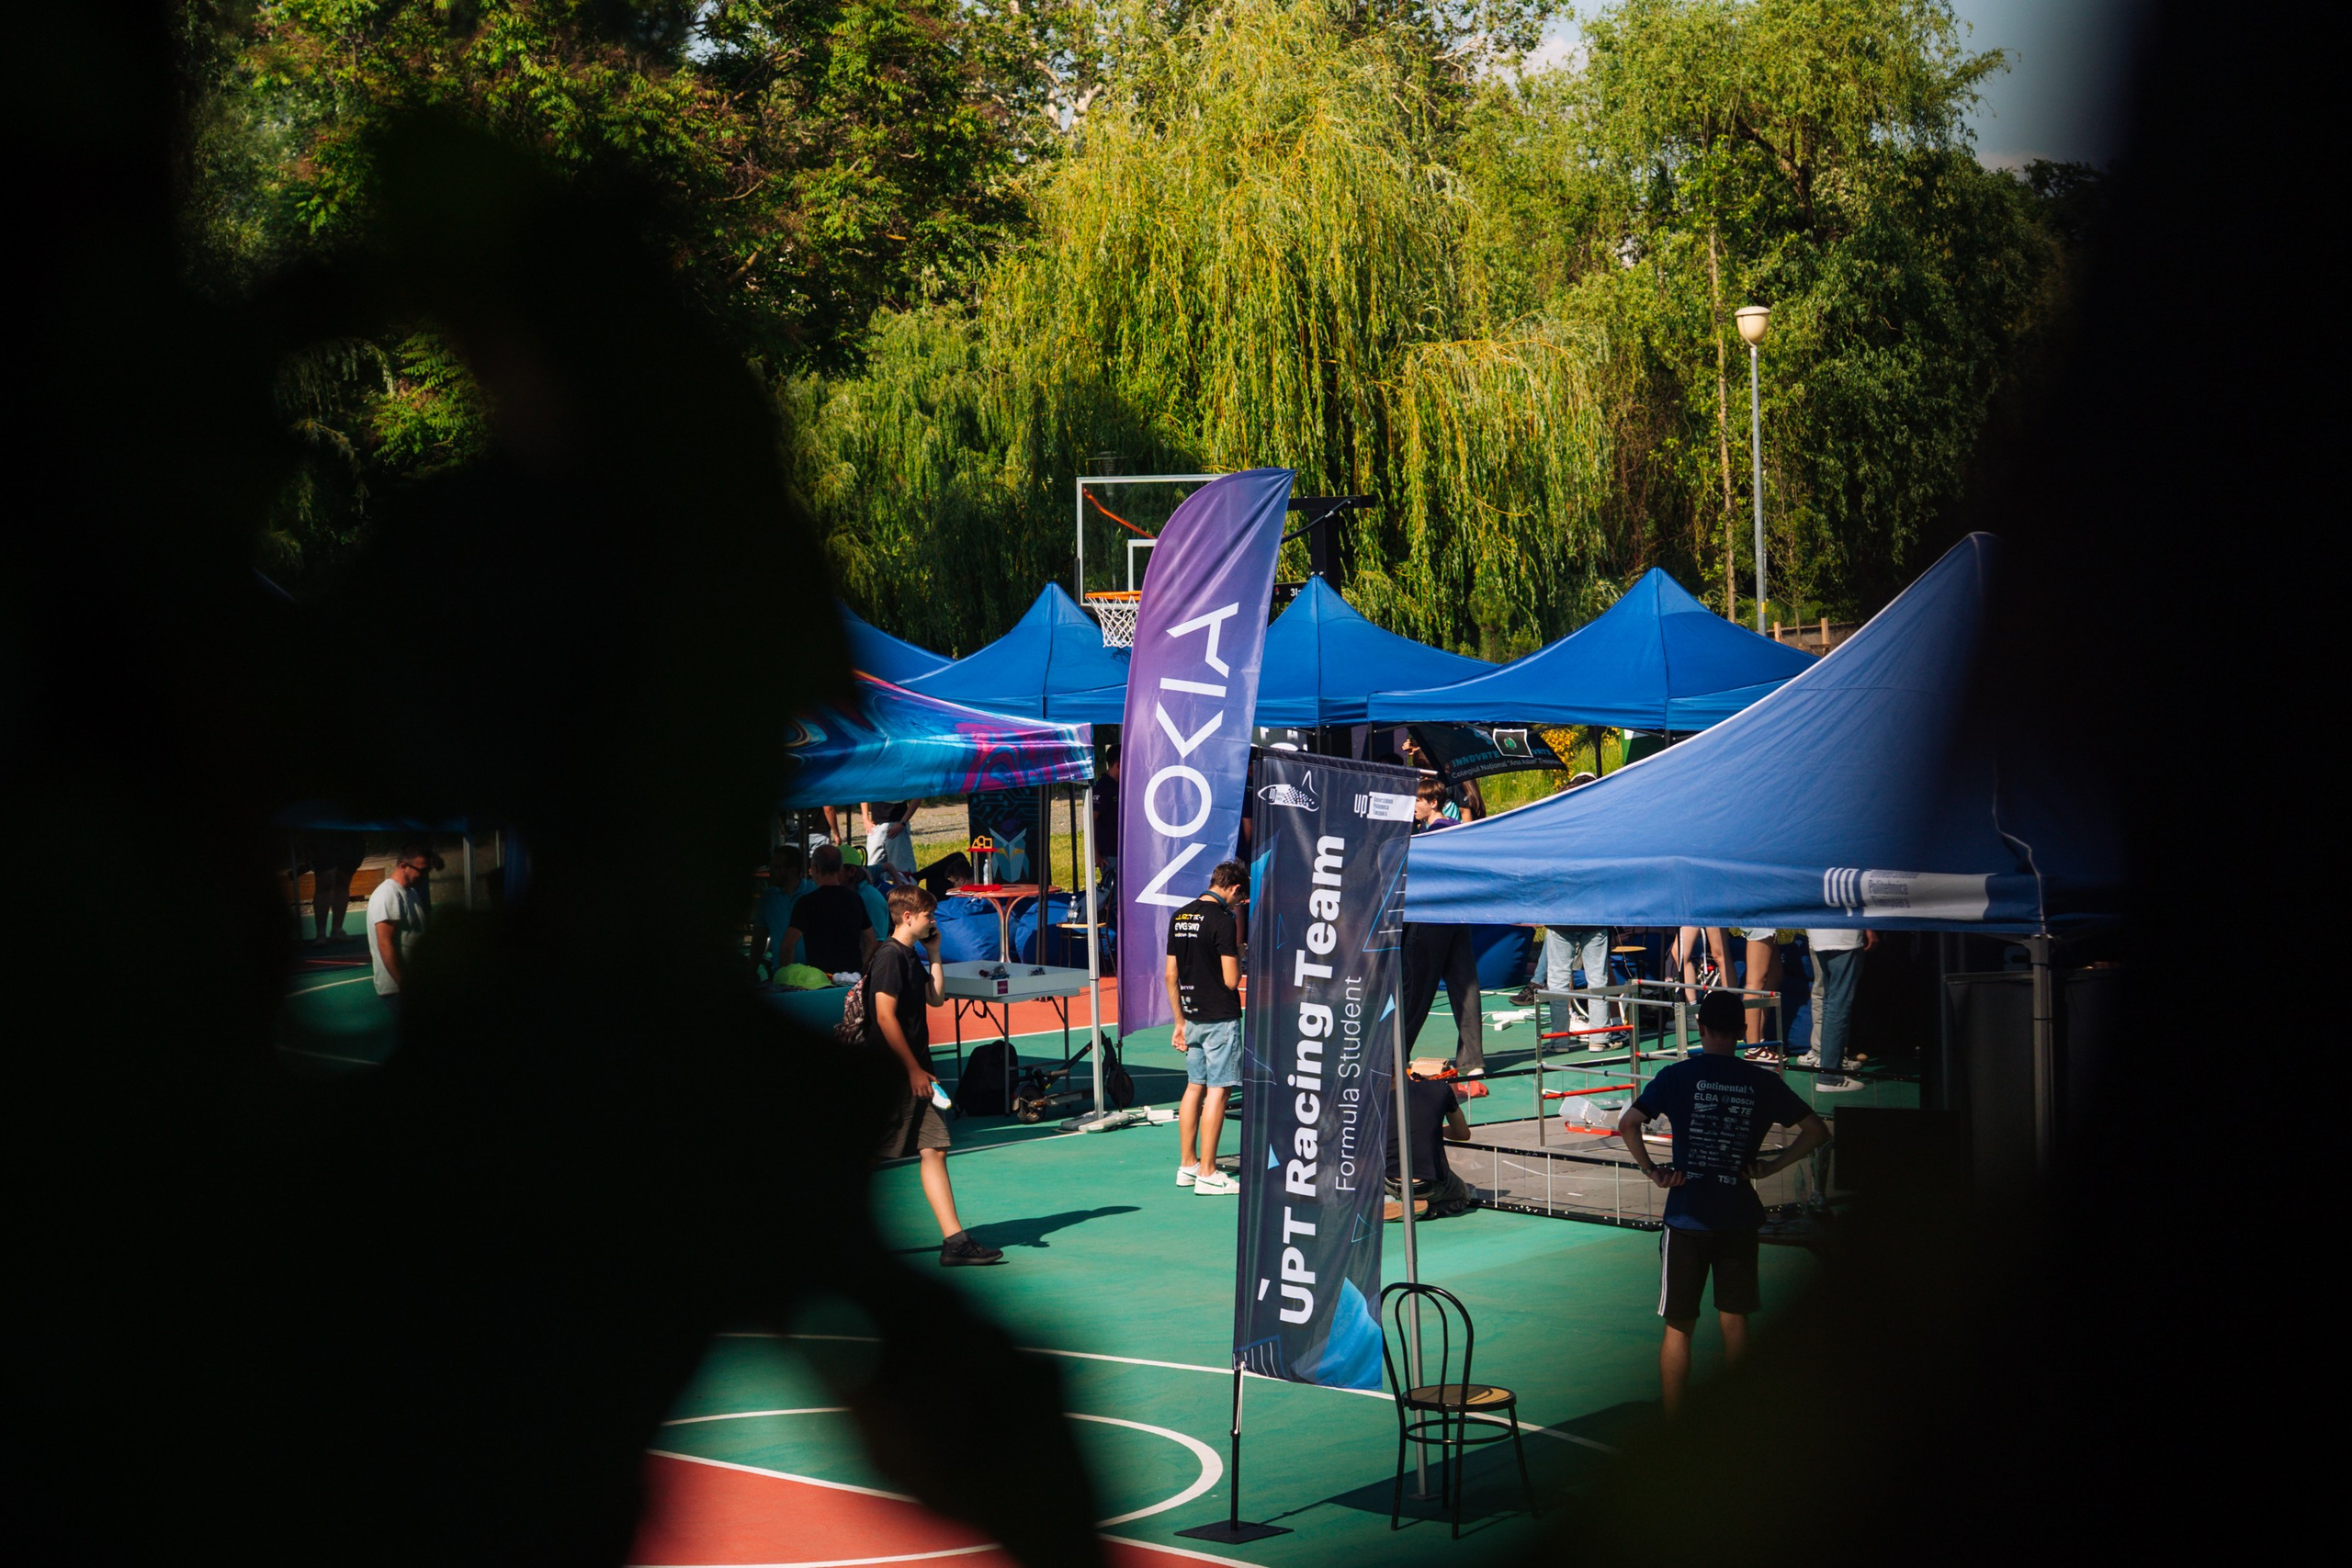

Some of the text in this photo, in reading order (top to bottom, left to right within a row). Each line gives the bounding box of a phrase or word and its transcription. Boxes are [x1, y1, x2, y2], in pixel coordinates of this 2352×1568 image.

[1136, 602, 1239, 908] NOKIA
[1294, 835, 1345, 987] Team
[1285, 1010, 1334, 1197] Racing
[1336, 976, 1362, 1191] Formula Student
[1693, 1092, 1755, 1106] ELBA BOSCH
[1696, 1079, 1747, 1094] Continental
